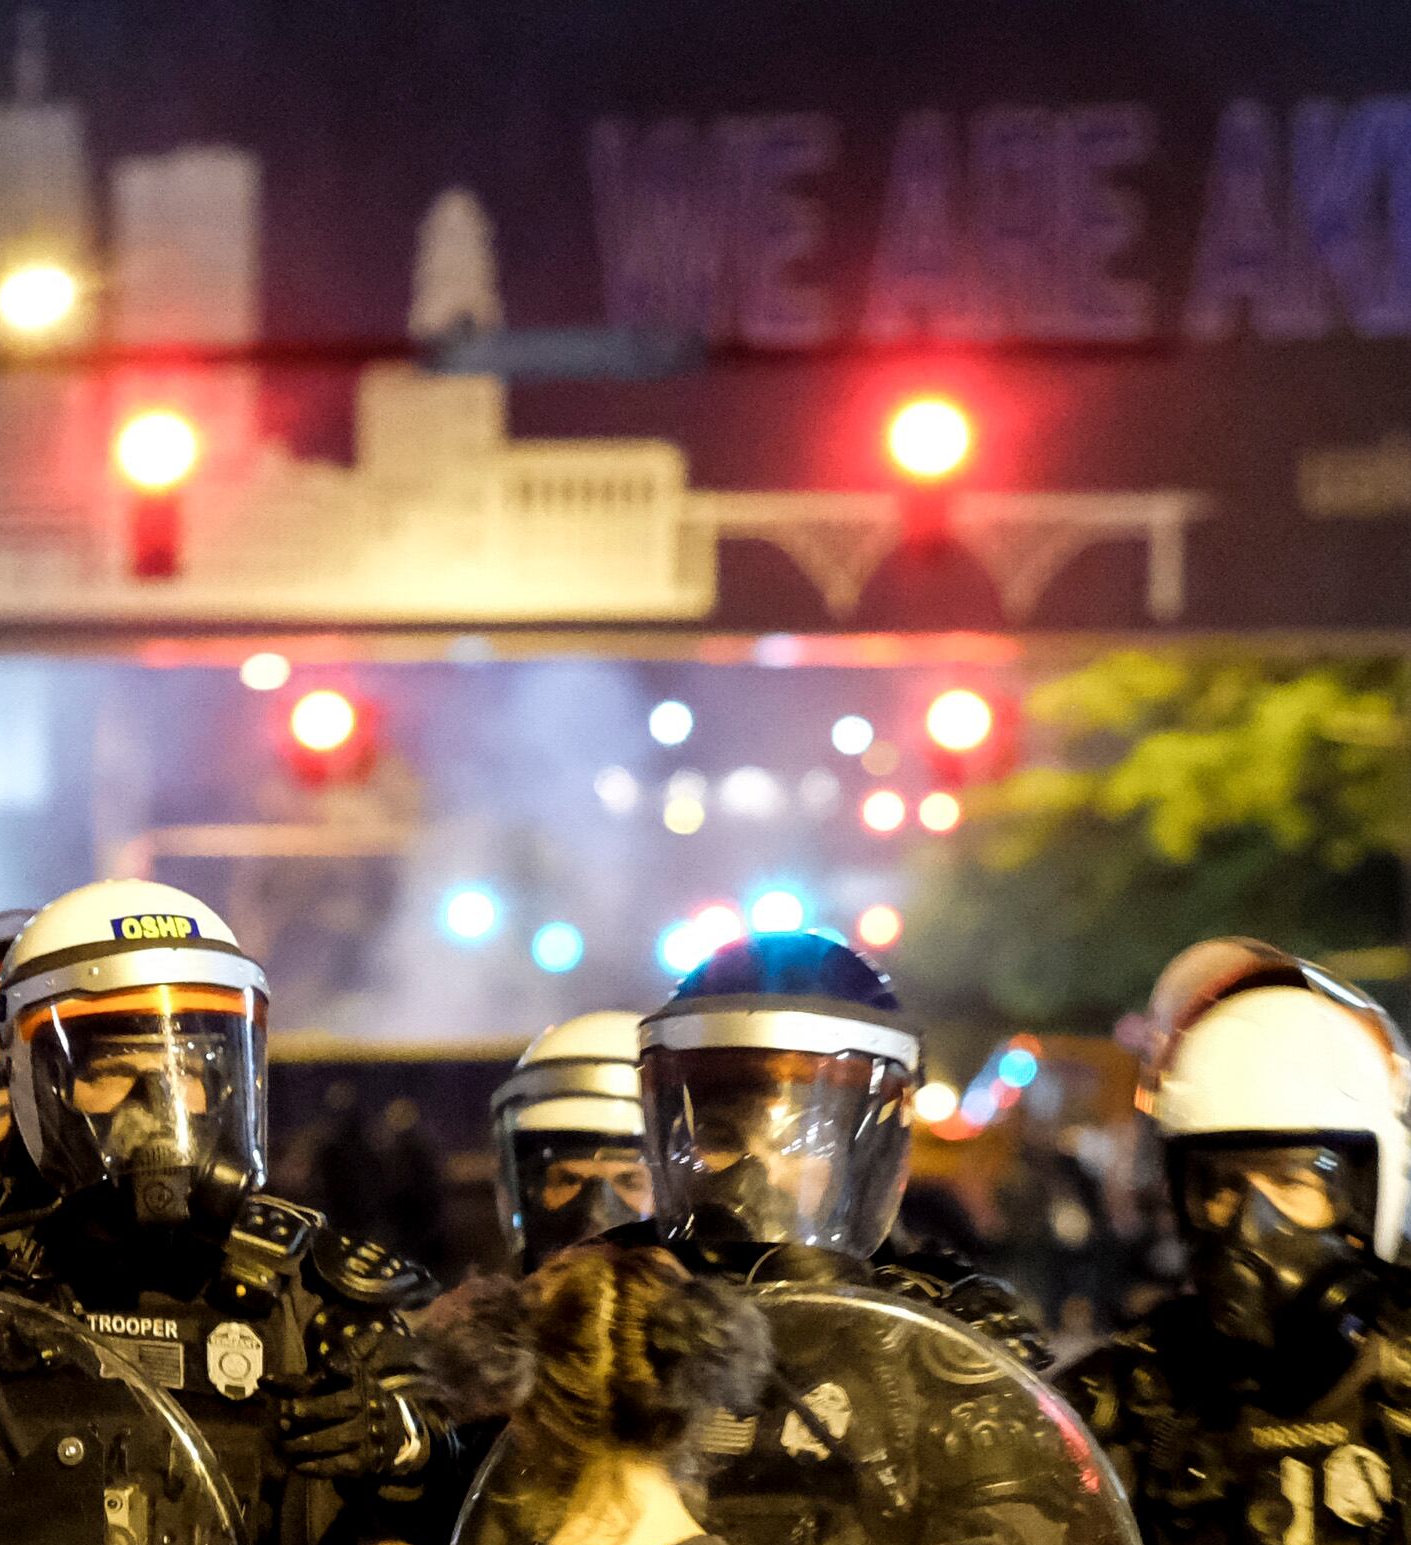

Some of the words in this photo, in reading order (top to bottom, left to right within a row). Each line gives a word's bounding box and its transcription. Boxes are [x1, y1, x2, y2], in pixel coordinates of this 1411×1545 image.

[588, 112, 841, 345] WE
[863, 102, 1157, 338] ARE
[121, 915, 192, 940] OSHP
[86, 1314, 178, 1339] TROOPER
